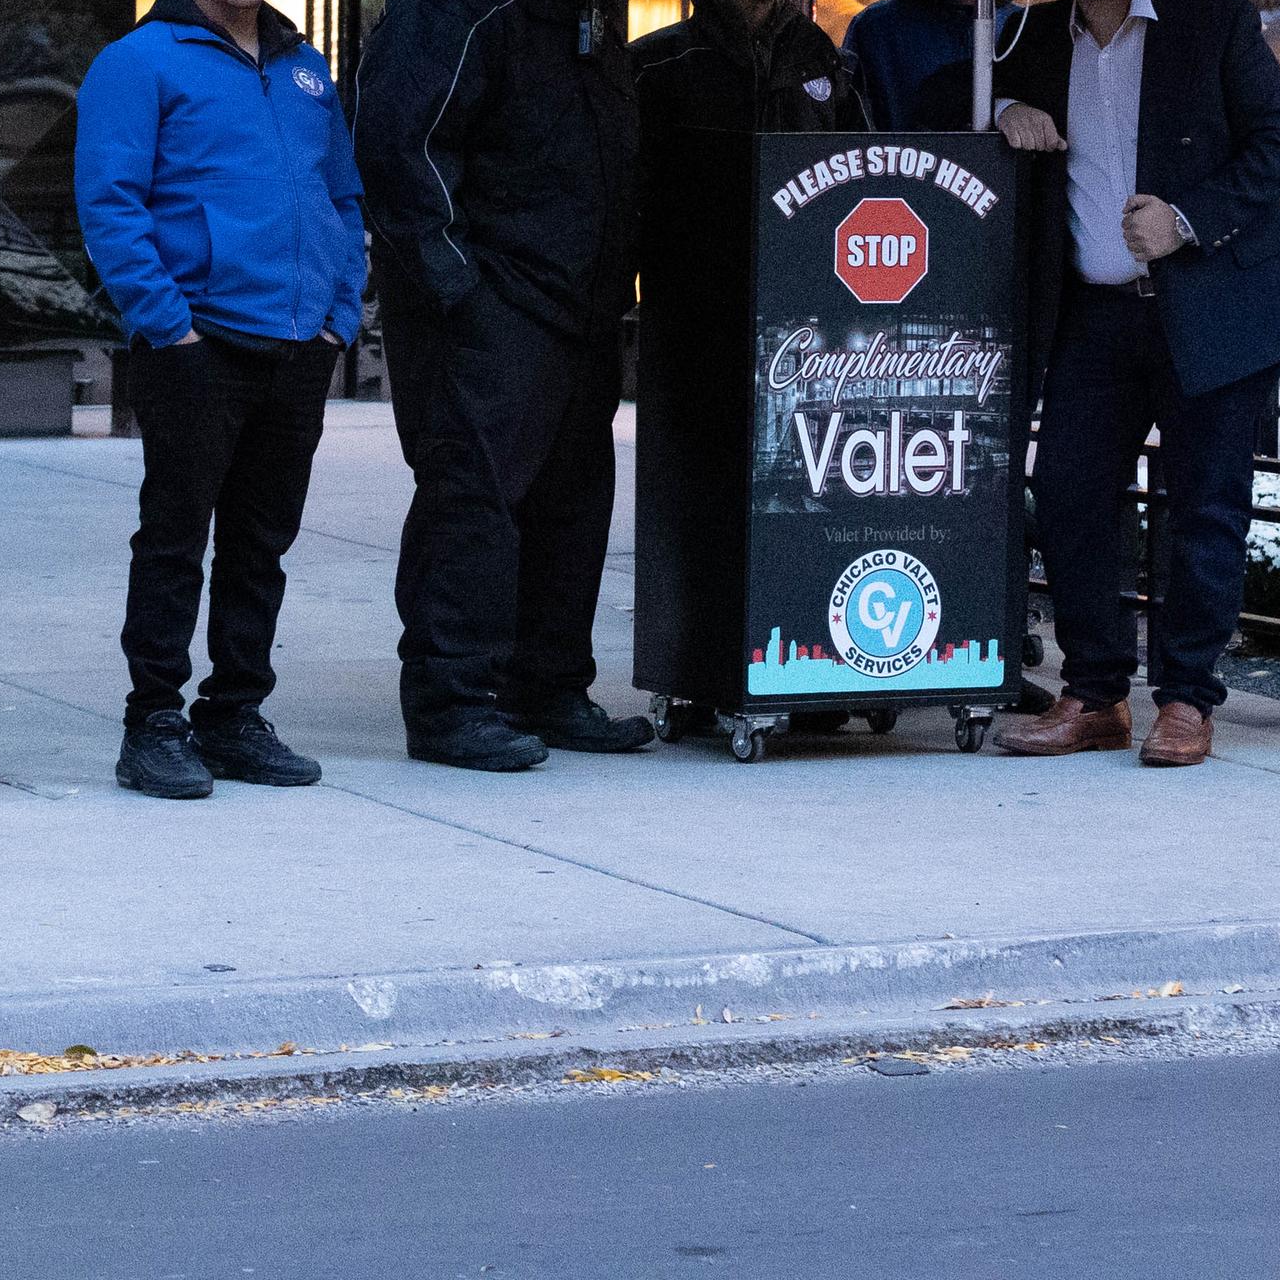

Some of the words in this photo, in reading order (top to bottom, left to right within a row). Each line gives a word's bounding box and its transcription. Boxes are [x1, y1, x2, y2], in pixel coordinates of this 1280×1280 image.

[772, 148, 864, 218] PLEASE
[866, 146, 937, 180] STOP
[934, 158, 999, 218] HERE
[847, 234, 917, 267] STOP
[769, 326, 1003, 406] Complimentary
[794, 409, 970, 495] Valet
[824, 526, 859, 543] Valet
[864, 525, 926, 542] Provided
[930, 525, 952, 545] by:
[832, 552, 897, 608] CHICAGO
[902, 556, 939, 606] VALET
[858, 581, 913, 649] CV
[845, 644, 923, 674] SERVICES
